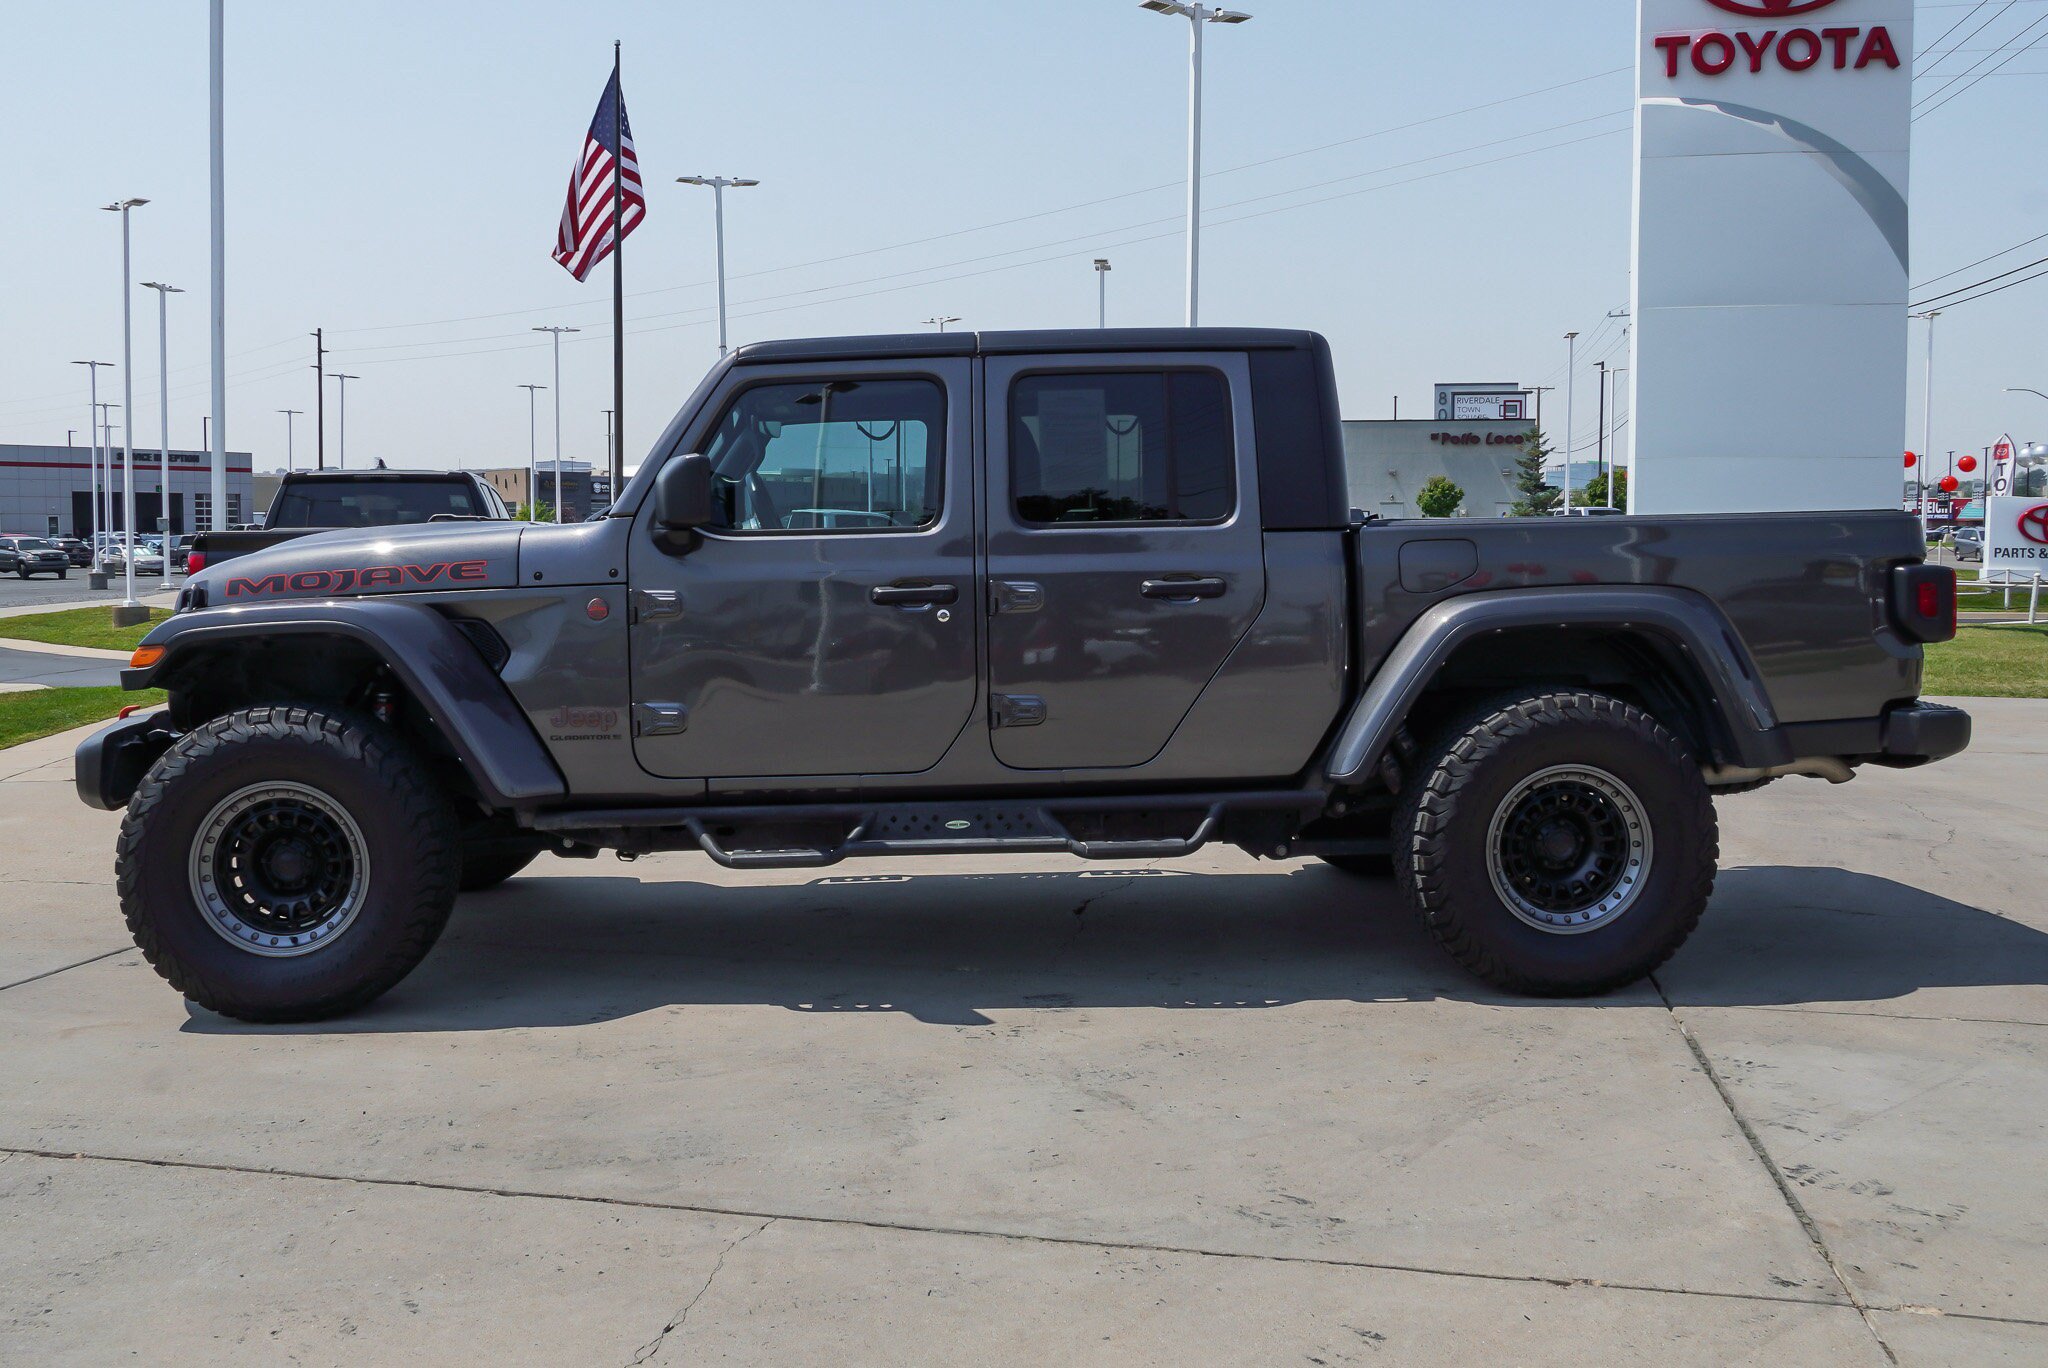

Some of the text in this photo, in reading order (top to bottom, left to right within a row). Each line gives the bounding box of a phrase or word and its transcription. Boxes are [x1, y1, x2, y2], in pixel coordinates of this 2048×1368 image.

[1654, 26, 1901, 78] TOYOTA
[1456, 396, 1500, 405] RIVERDALE
[1441, 432, 1481, 445] Pollo
[1486, 432, 1524, 445] Loco
[116, 452, 200, 463] SVICE REPTION
[1994, 548, 2048, 559] PARTS &
[224, 560, 488, 597] MOJAVE
[550, 705, 618, 732] Jeep
